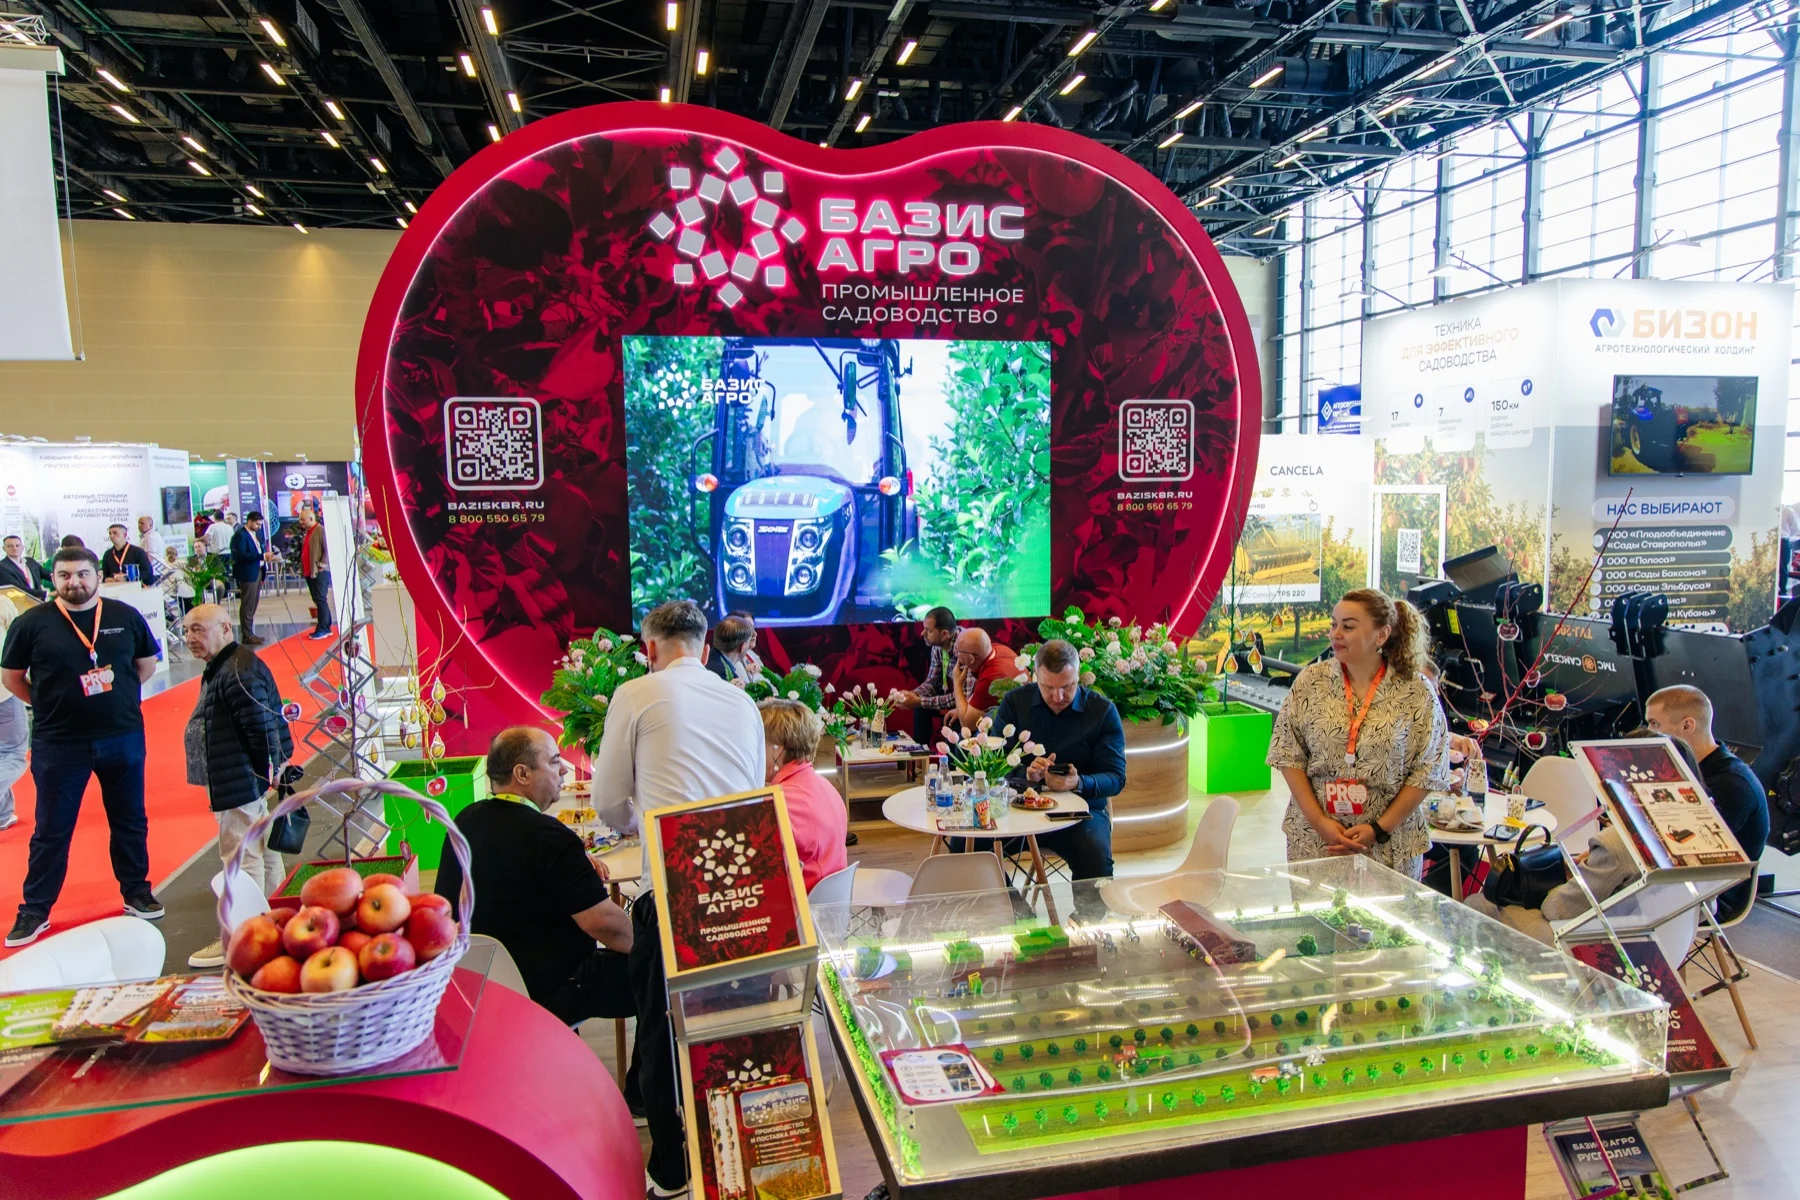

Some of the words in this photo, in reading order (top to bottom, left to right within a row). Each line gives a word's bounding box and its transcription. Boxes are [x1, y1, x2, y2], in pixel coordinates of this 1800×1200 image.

[820, 198, 1025, 240] БАЗИС
[818, 238, 980, 275] АГРО
[821, 284, 1024, 304] ПРОМЫШЛЕННОЕ
[821, 306, 998, 325] САДОВОДСТВО
[1434, 317, 1482, 337] ТЕХНИКА
[1632, 309, 1758, 340] БИЗОН
[1402, 344, 1424, 360] ДЛЯ
[1425, 328, 1519, 356] ЭФФЕКТИВНОГО
[1595, 344, 1710, 354] АГРОТЕХНОЛОГИЧЕСКИЙ
[1714, 346, 1755, 355] ХОЛДИНГ
[1418, 349, 1497, 372] САДОВОДСТВА
[701, 378, 765, 392] БАЗИС
[701, 392, 752, 404] АГРО
[1491, 400, 1508, 411] 150
[1509, 402, 1519, 410] км
[1391, 411, 1399, 421] 17
[1438, 407, 1444, 417] 7
[1270, 466, 1324, 476] CANCELA
[1117, 491, 1193, 500] BAZISKBR.RU
[448, 501, 545, 510] BAZISKBR.RU
[1117, 503, 1123, 511] 8
[1126, 503, 1144, 511] 800
[1147, 502, 1164, 510] 550
[1167, 502, 1178, 510] 65
[1181, 502, 1193, 510] 79
[1607, 503, 1637, 515] НАС
[1641, 502, 1722, 514] ВЫБИРАЮТ
[448, 515, 456, 523] 8
[460, 515, 483, 523] 800
[486, 514, 508, 523] 550
[512, 514, 527, 522] 65
[531, 513, 545, 522] 79
[1608, 531, 1628, 539] ООО
[1630, 529, 1726, 538] «Плодообъединение
[1608, 541, 1639, 550] «Сады
[1641, 540, 1707, 549] Ставрополья»
[1607, 557, 1627, 565] ООО
[1629, 556, 1676, 564] «Полоса»
[1606, 571, 1626, 579] ООО
[1628, 571, 1660, 580] «Сады
[1661, 569, 1707, 577] Баксана»
[1661, 582, 1711, 592] Эльбруса»
[1677, 609, 1716, 619] Кубань»
[1543, 652, 1582, 666] CANCELA
[697, 884, 765, 904] БАЗИС
[706, 897, 758, 915] АГРО
[700, 916, 771, 935] ПРОМЫШЛЕННОЕ
[706, 925, 768, 942] САДОВОДСТВО
[772, 1096, 806, 1109] БАЗИС
[772, 1105, 800, 1115] АГРО
[755, 1121, 804, 1135] ПРОИЗВОДСТВО
[756, 1131, 788, 1142] ПОСТАВКА
[1610, 1136, 1636, 1147] АГРО
